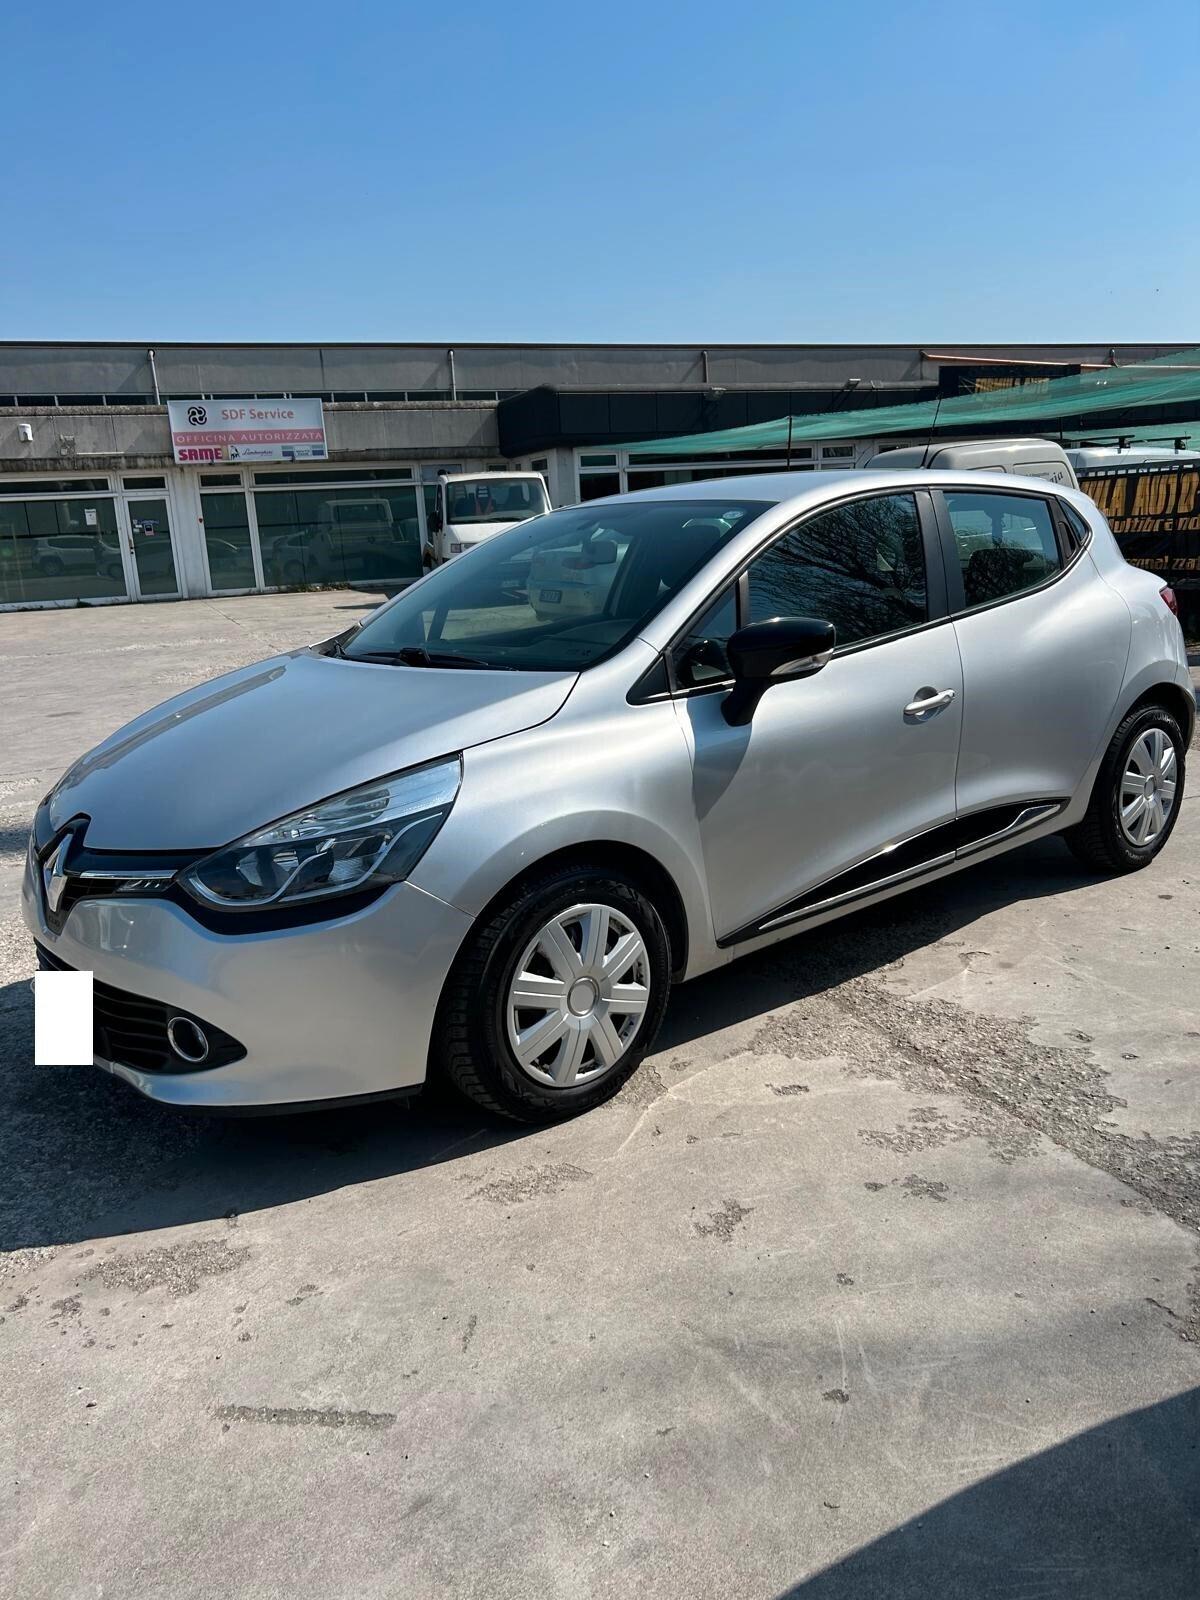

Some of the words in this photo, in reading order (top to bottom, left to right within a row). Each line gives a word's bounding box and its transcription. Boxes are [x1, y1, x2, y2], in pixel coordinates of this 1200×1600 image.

[221, 409, 246, 420] SDF
[249, 408, 295, 420] Service
[176, 434, 237, 444] OFFICINA
[240, 432, 323, 442] AUTORIZZATA
[178, 448, 223, 461] SAME
